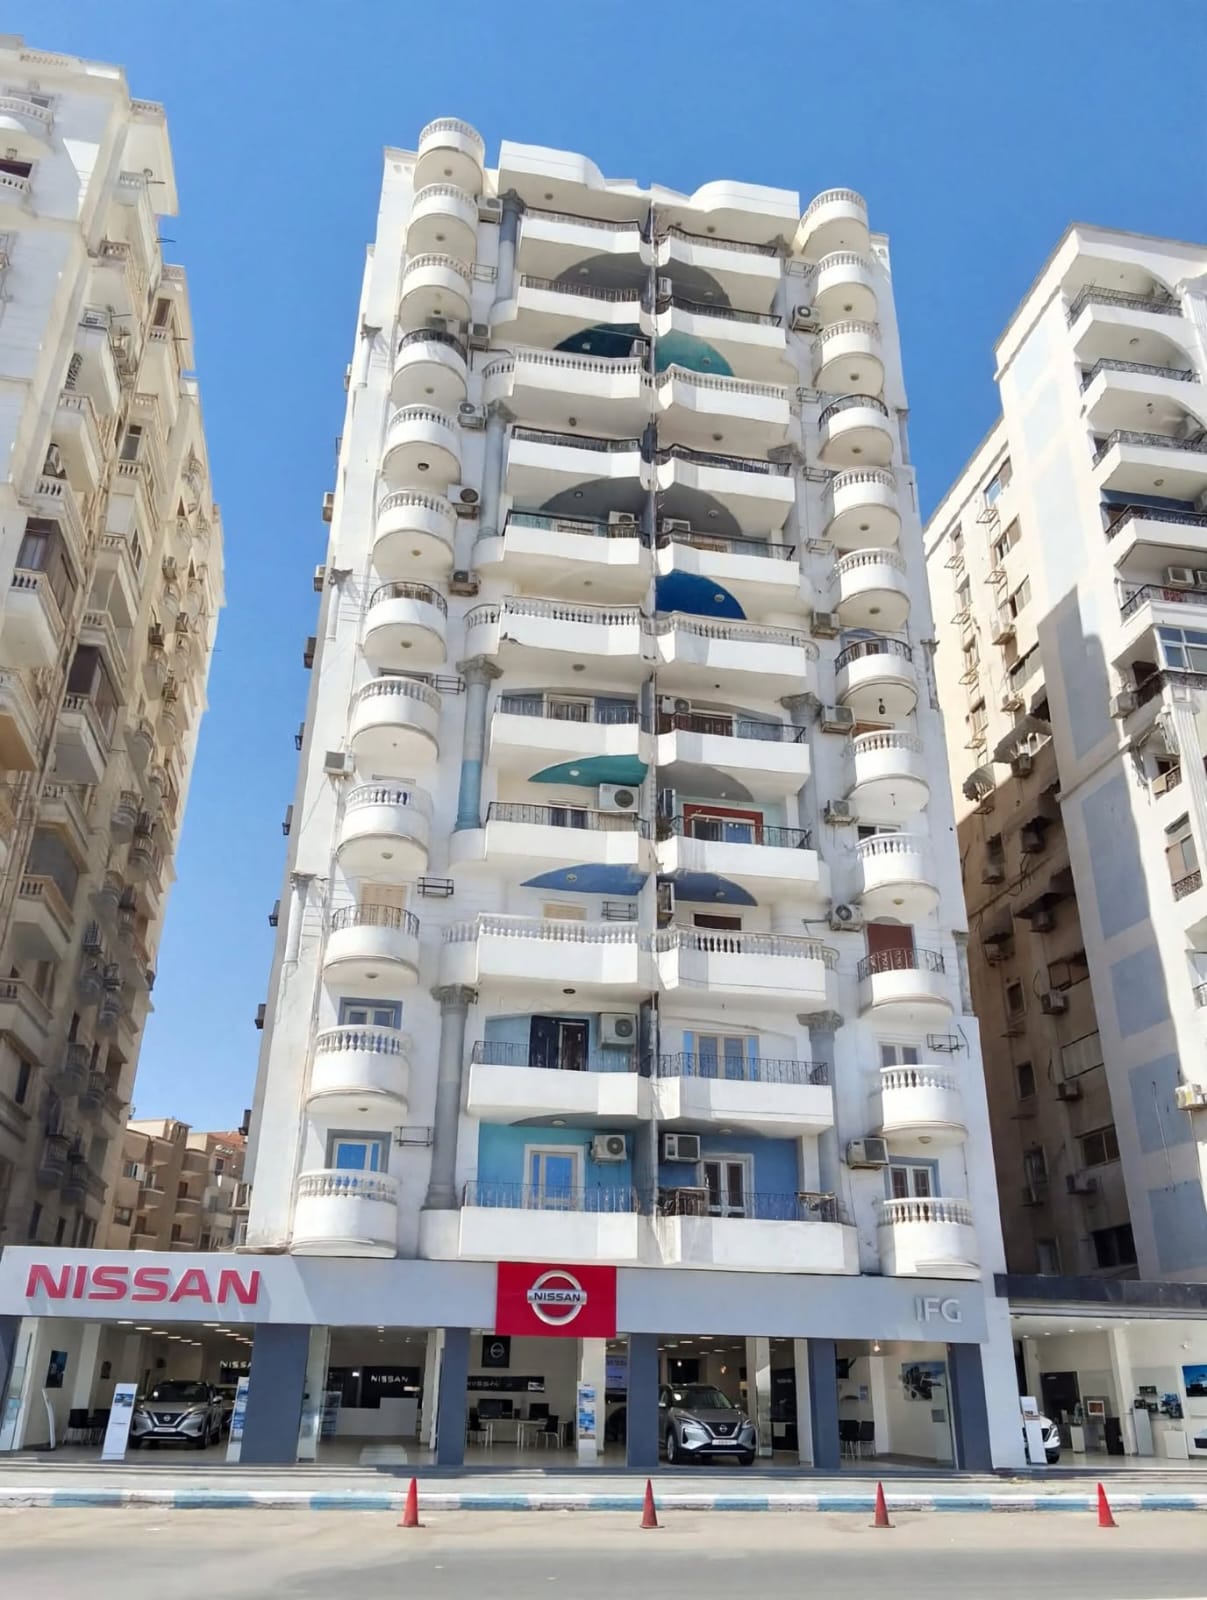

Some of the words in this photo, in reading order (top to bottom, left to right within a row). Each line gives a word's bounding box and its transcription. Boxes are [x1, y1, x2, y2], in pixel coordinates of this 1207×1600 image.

[25, 1264, 261, 1304] NISSAN
[534, 1292, 581, 1302] NISSAN
[914, 1297, 962, 1323] IFG
[370, 1375, 409, 1383] NISSAN
